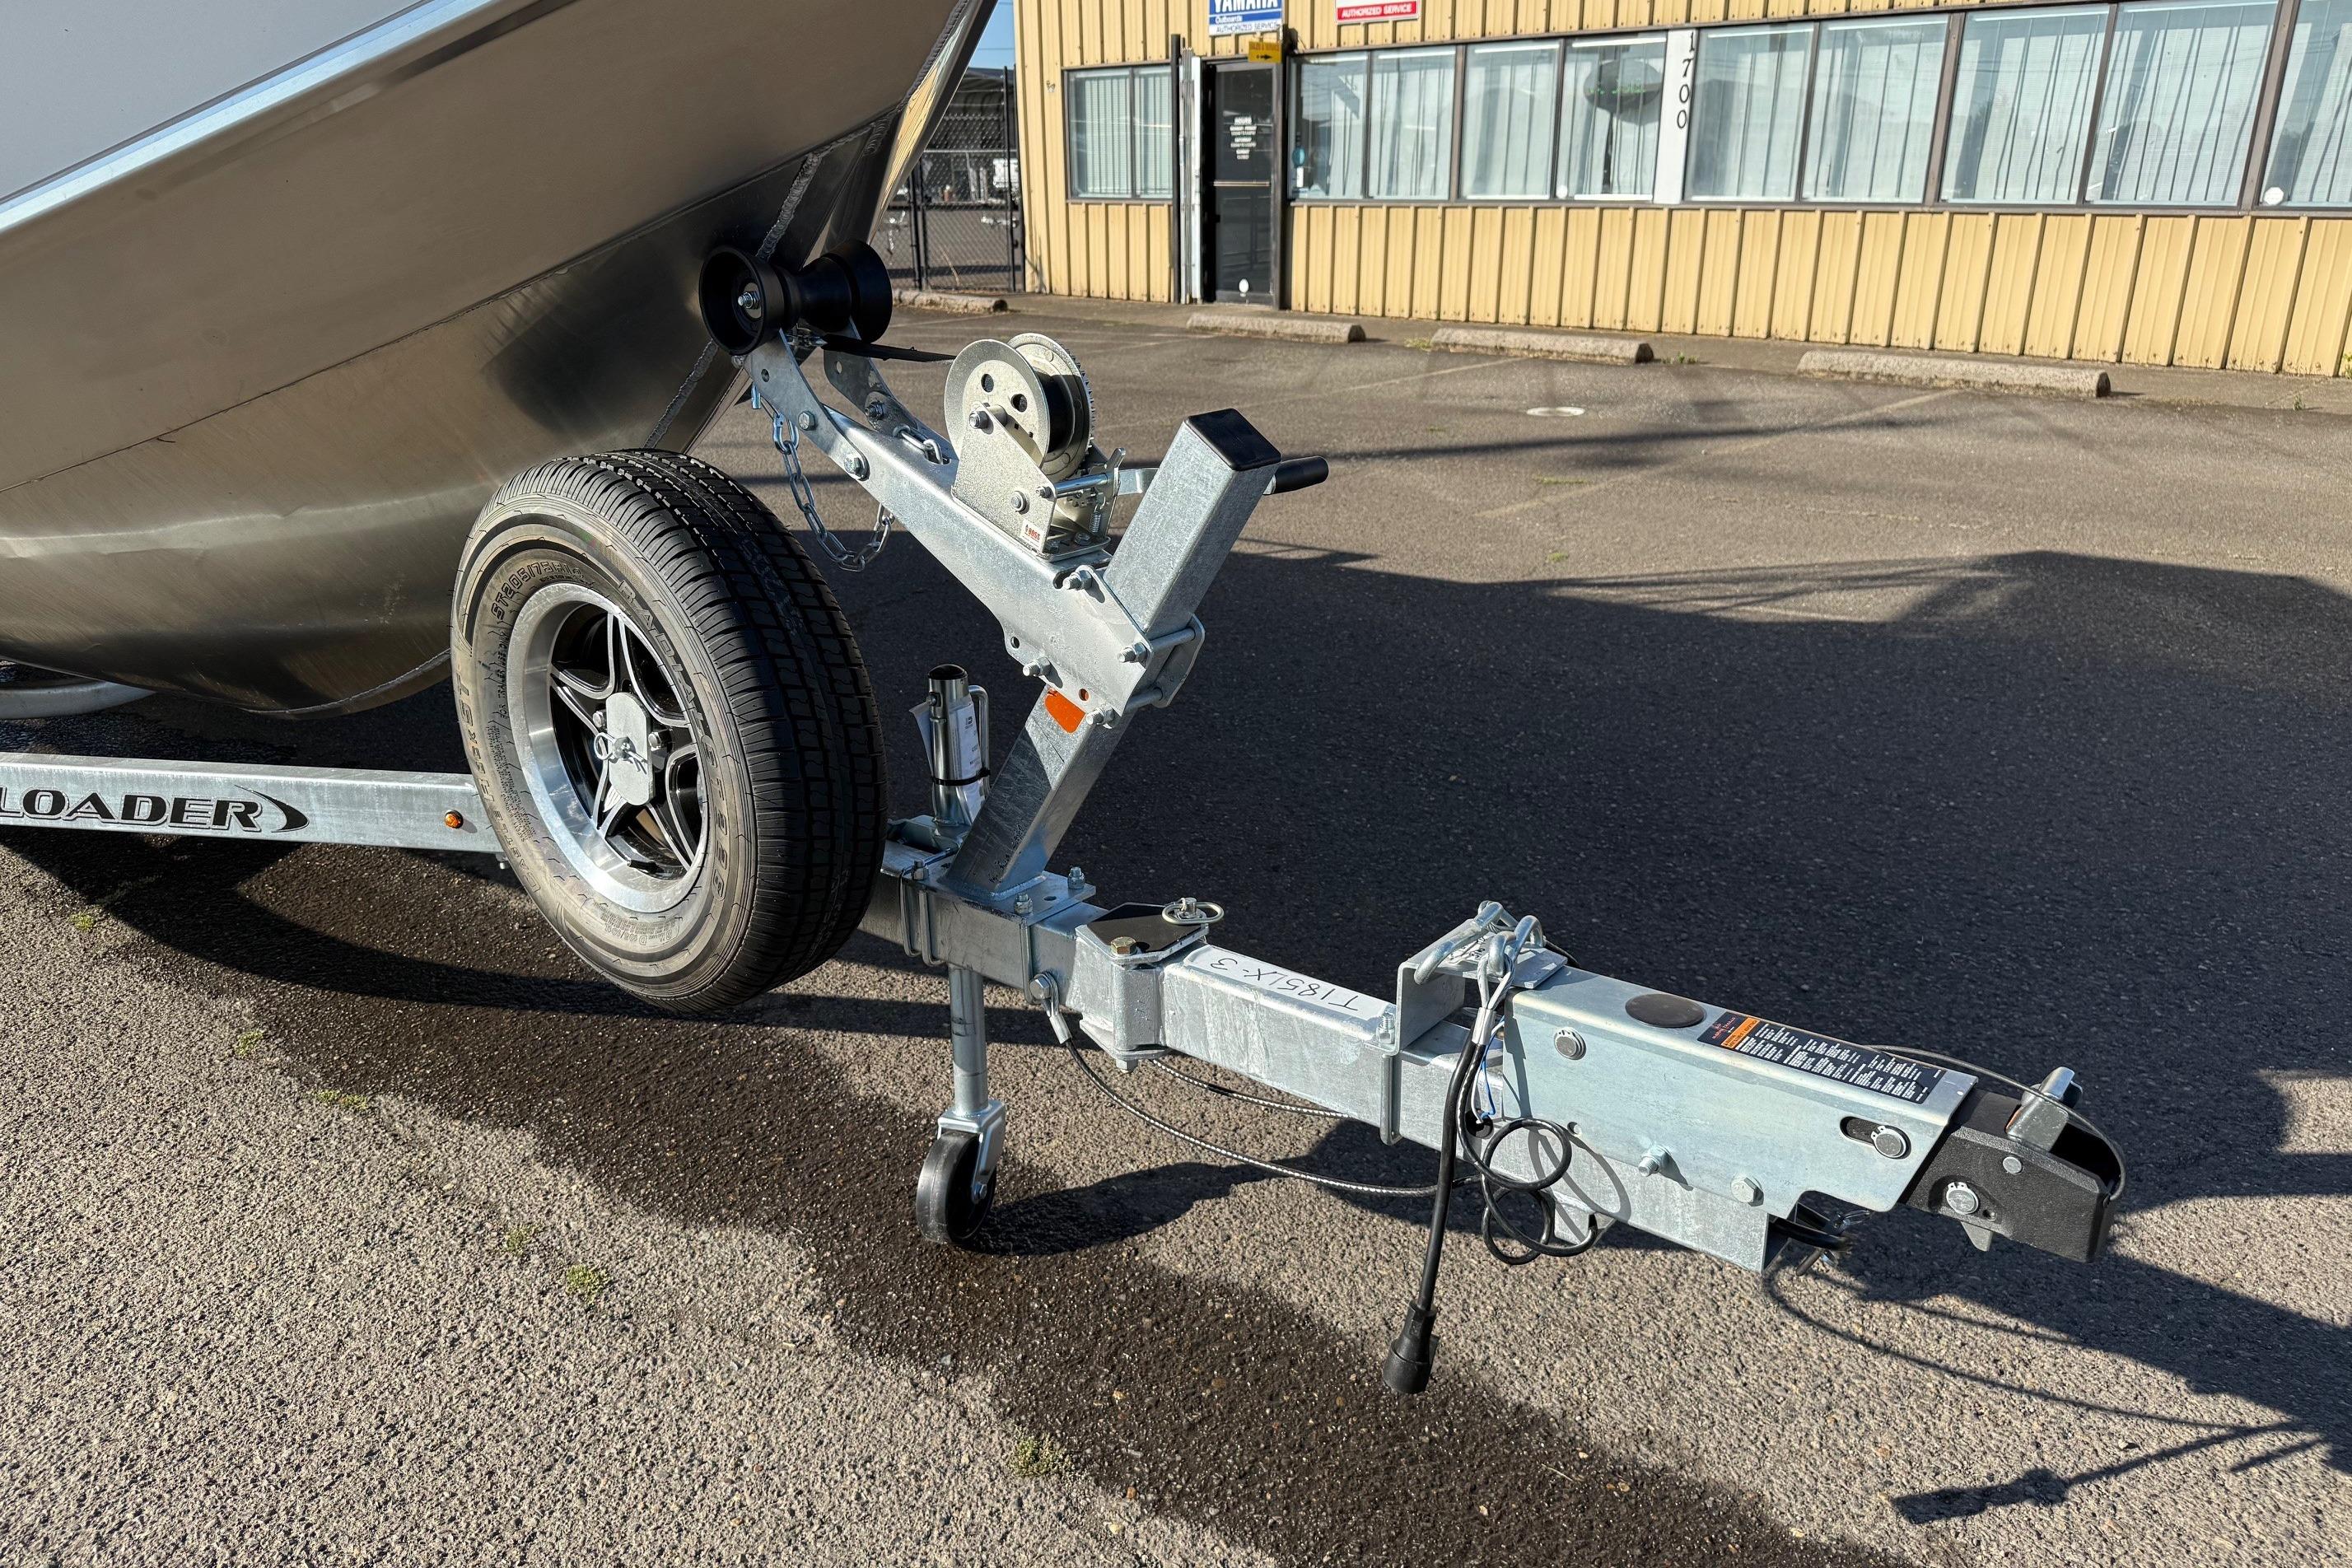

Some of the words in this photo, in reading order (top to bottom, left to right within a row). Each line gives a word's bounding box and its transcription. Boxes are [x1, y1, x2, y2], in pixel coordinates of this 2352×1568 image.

[1384, 3, 1412, 14] SERVICE
[1677, 31, 1695, 128] 1700
[618, 580, 704, 730] RADIAL
